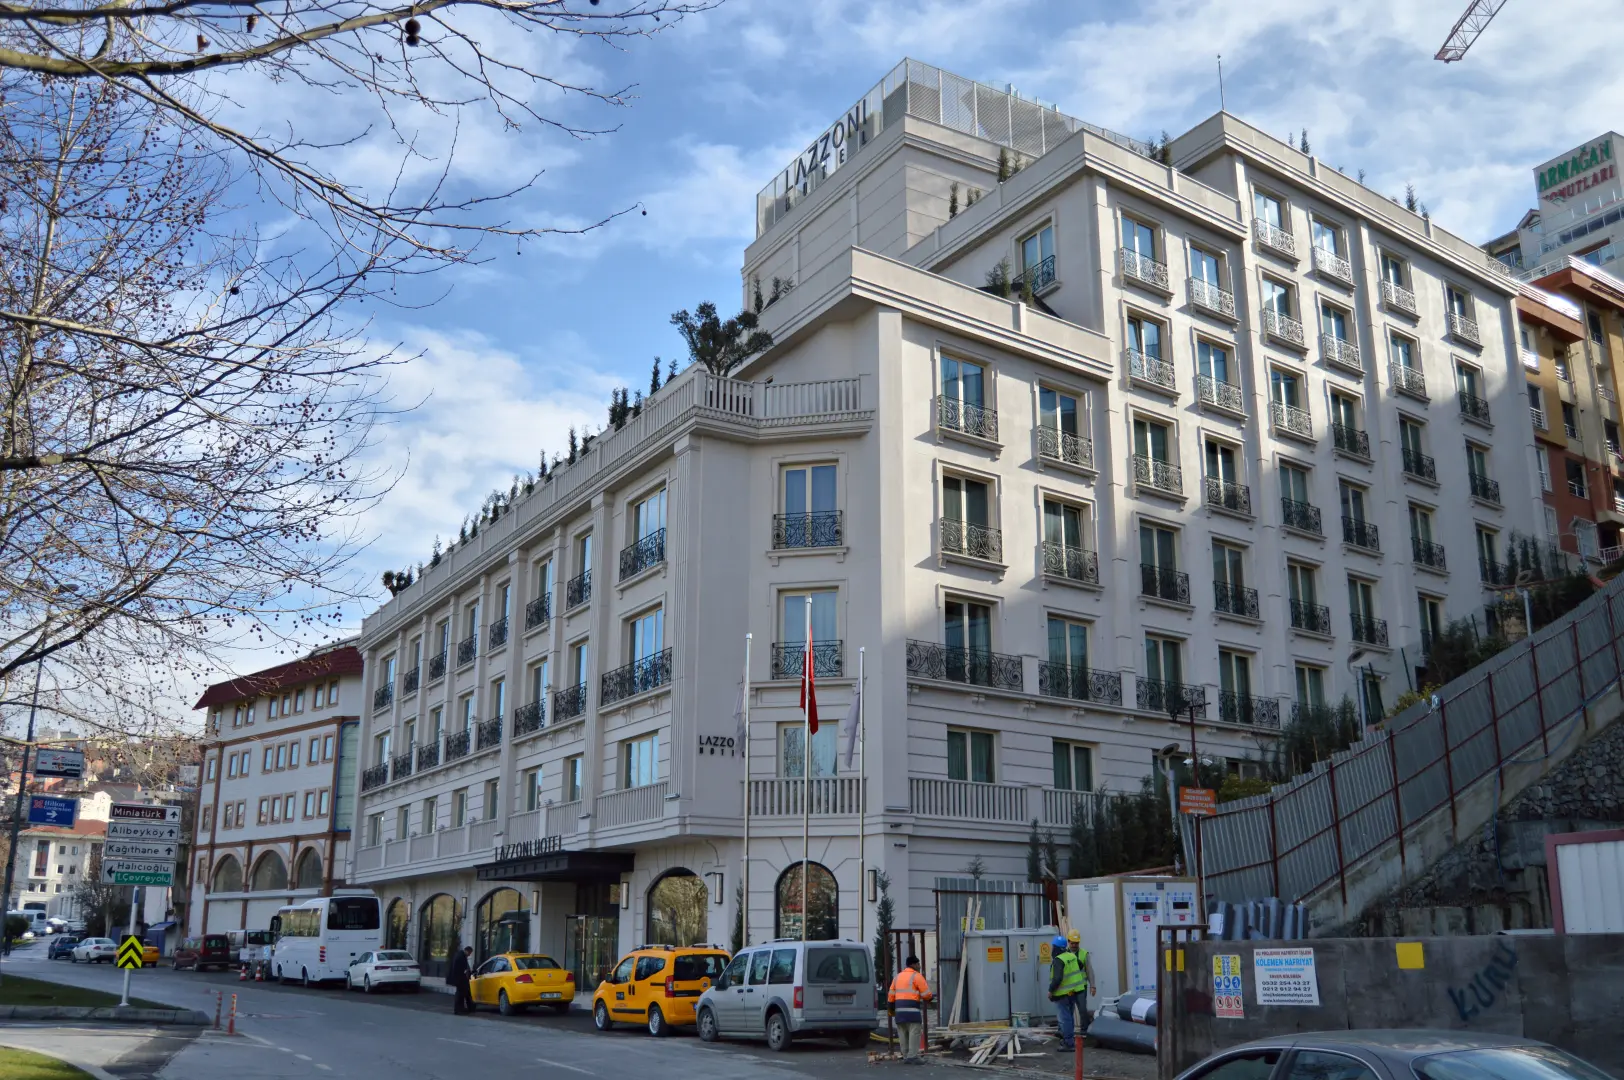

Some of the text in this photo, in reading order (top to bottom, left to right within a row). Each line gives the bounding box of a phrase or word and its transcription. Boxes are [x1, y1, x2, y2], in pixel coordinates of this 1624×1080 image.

[784, 99, 867, 194] LAZZONI
[1538, 139, 1613, 193] ARMAĞAN
[699, 734, 735, 748] LAZZO
[114, 807, 161, 818] Miniatürk
[110, 826, 165, 838] Alibeyköy
[108, 844, 160, 855] Kağıthane
[495, 834, 562, 861] LAZZONI HOTEL
[117, 861, 170, 873] Halıcıoğlu
